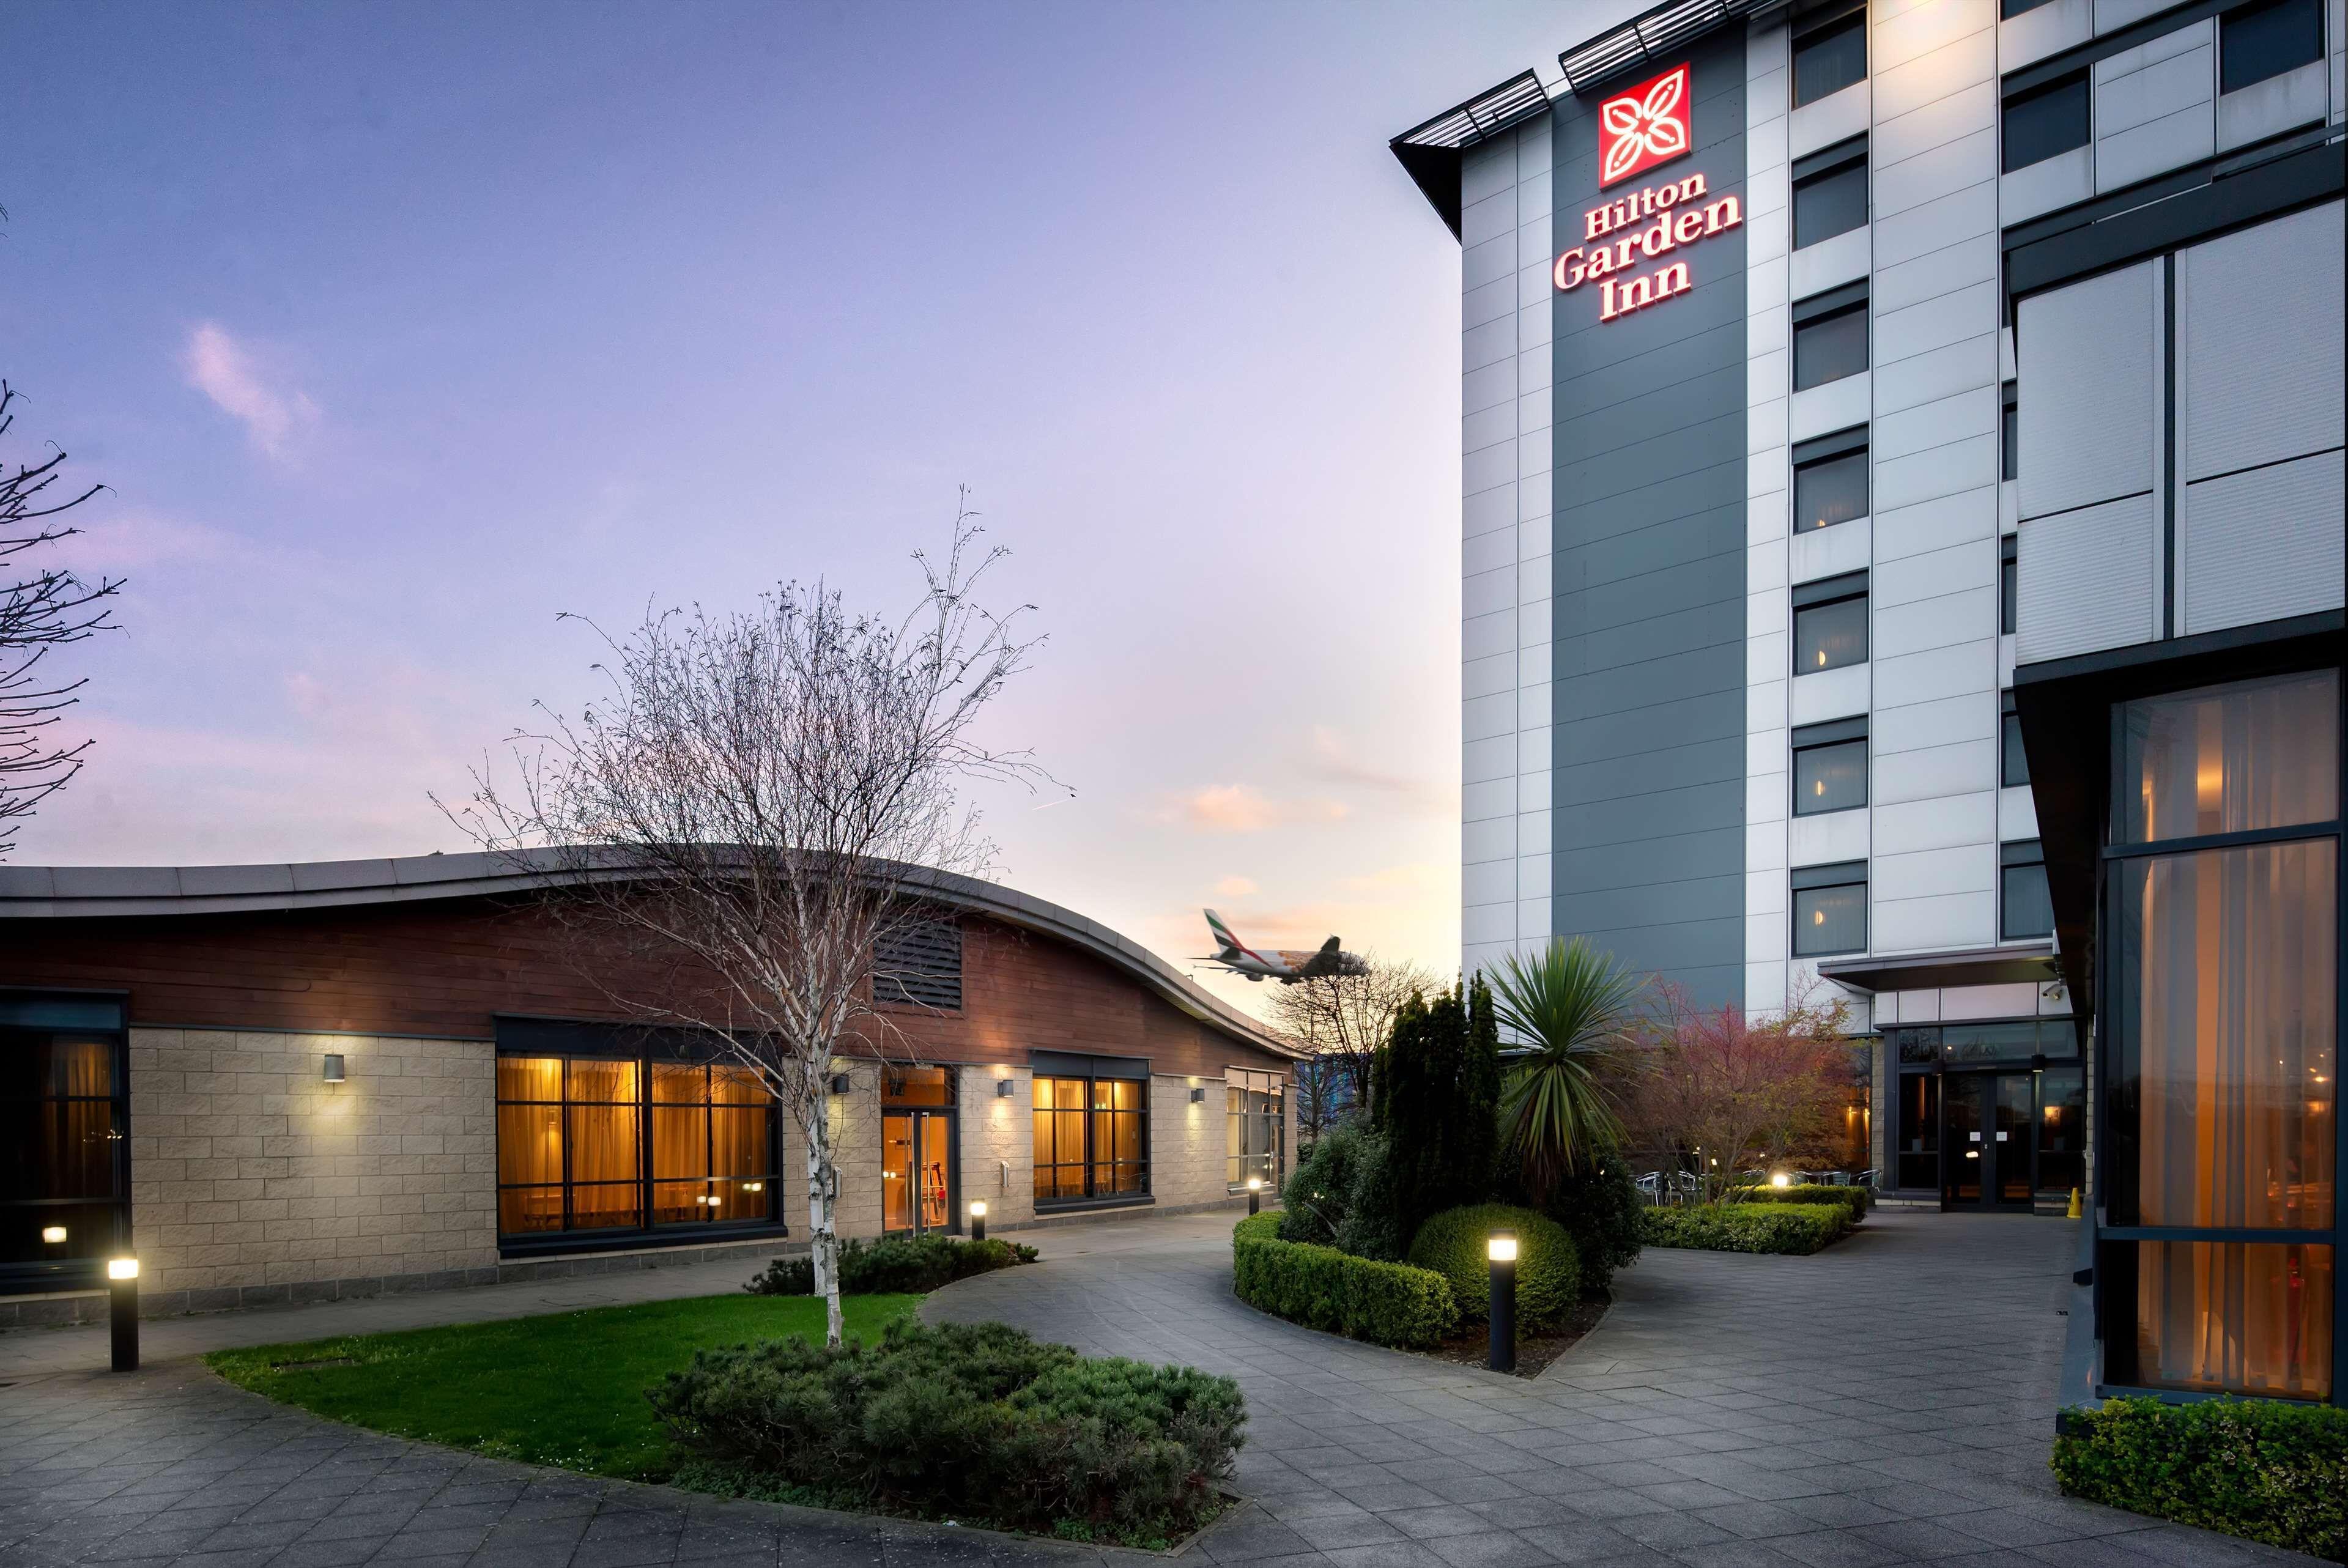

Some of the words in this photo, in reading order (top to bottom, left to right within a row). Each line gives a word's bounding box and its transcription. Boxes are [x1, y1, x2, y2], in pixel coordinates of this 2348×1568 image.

[1584, 172, 1708, 241] Hilton
[1554, 195, 1742, 290] Garden
[1599, 262, 1692, 322] Inn
